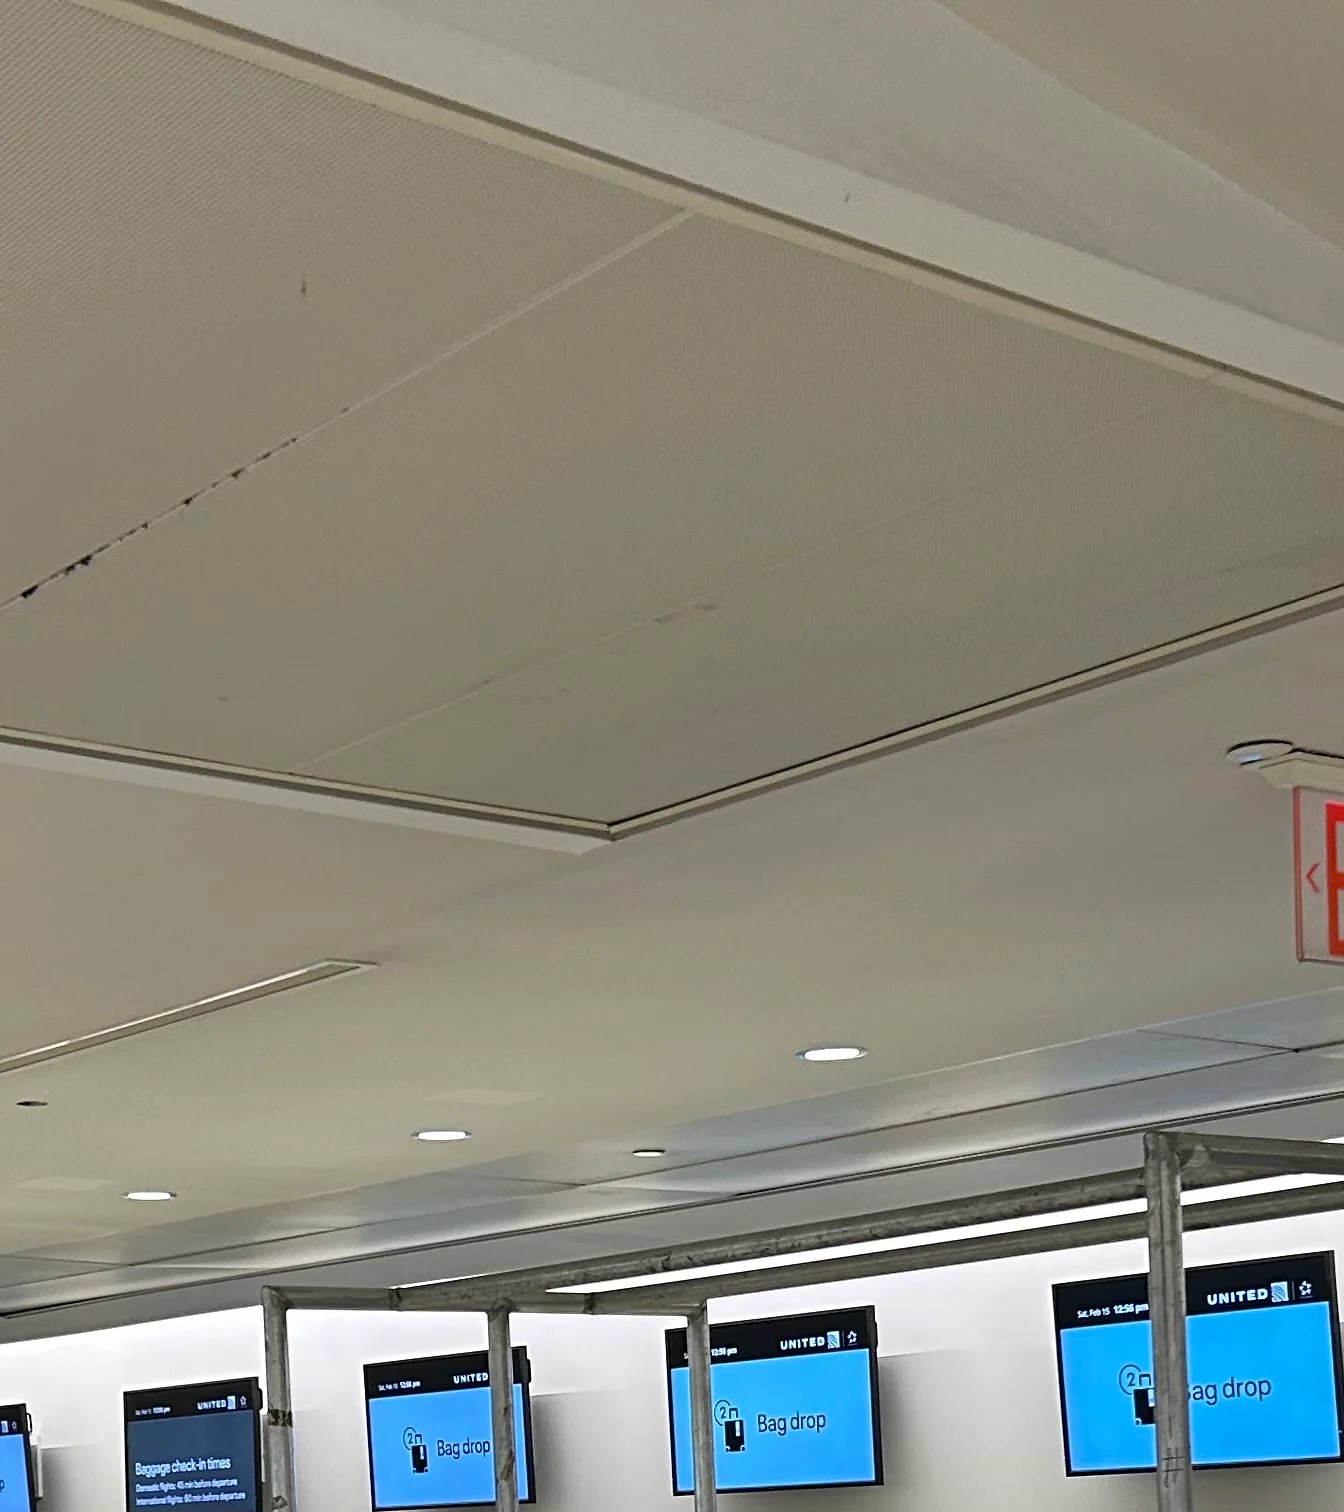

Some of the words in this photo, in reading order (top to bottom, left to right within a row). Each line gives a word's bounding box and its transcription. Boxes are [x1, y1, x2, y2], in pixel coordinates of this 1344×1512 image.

[1207, 1287, 1268, 1306] UNITED
[779, 1336, 826, 1351] UNITED
[453, 1371, 489, 1384] UNITED
[1185, 1383, 1218, 1406] ag
[1222, 1376, 1272, 1402] drop
[197, 1399, 227, 1411] UNITED
[757, 1413, 787, 1437] Bag
[790, 1411, 827, 1434] drop
[436, 1439, 460, 1460] Bag
[462, 1437, 491, 1458] drop
[135, 1462, 171, 1478] Baggage
[171, 1457, 207, 1473] check-in
[207, 1456, 231, 1469] times
